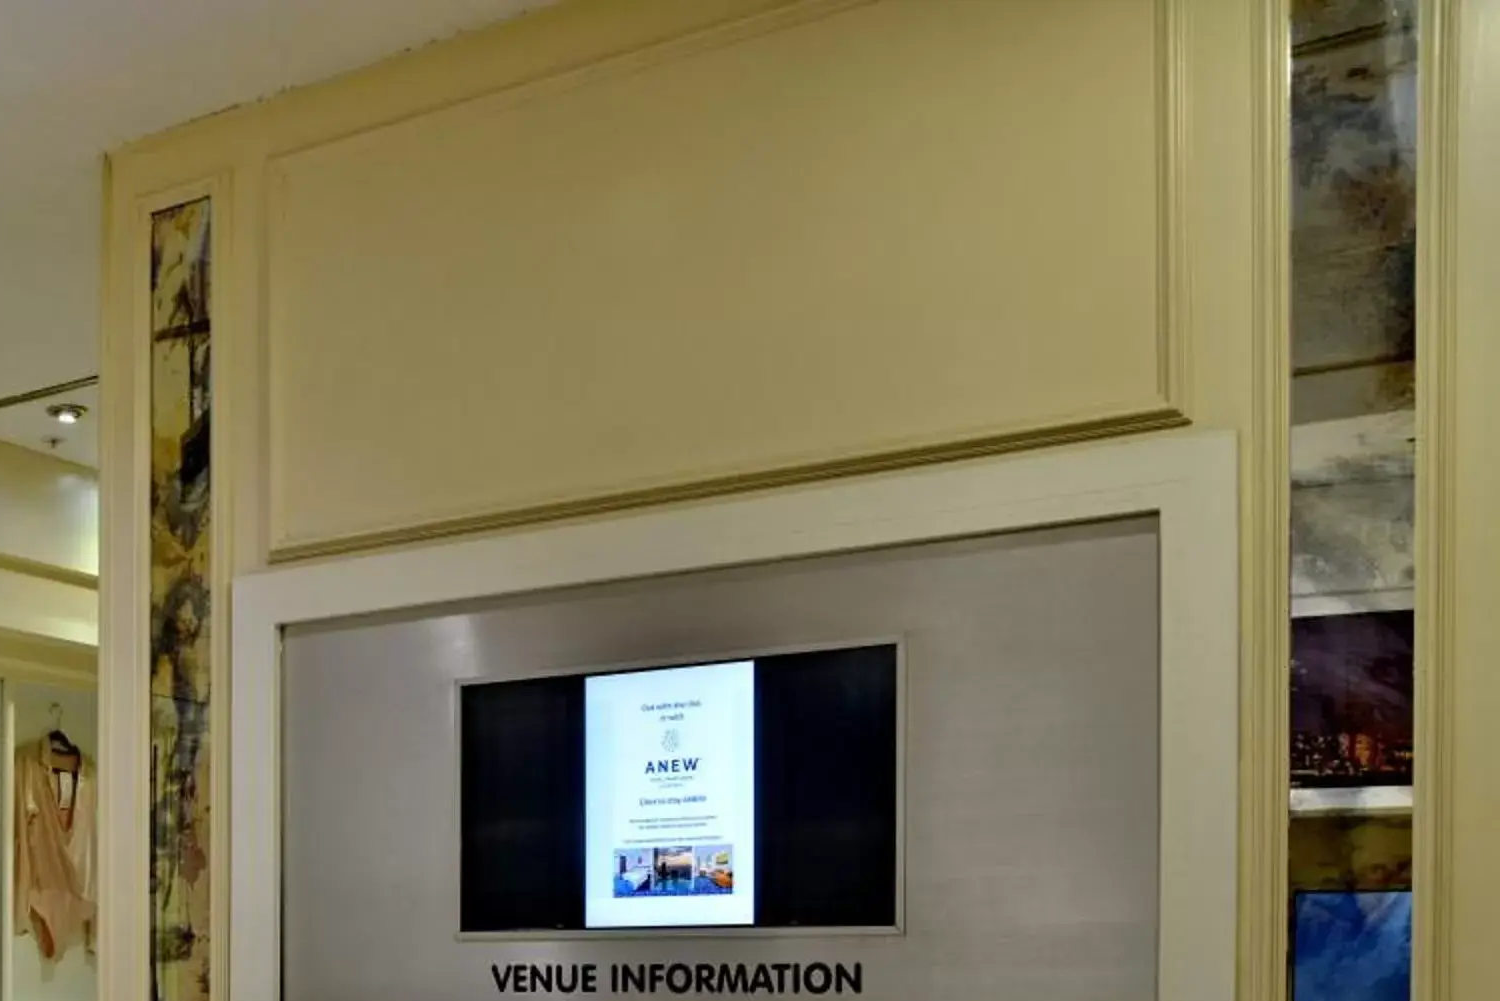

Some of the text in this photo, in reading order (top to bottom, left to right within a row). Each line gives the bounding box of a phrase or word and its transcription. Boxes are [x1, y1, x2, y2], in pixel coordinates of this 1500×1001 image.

[644, 757, 699, 774] ANEW
[492, 962, 863, 994] VENUE INFORMATION
